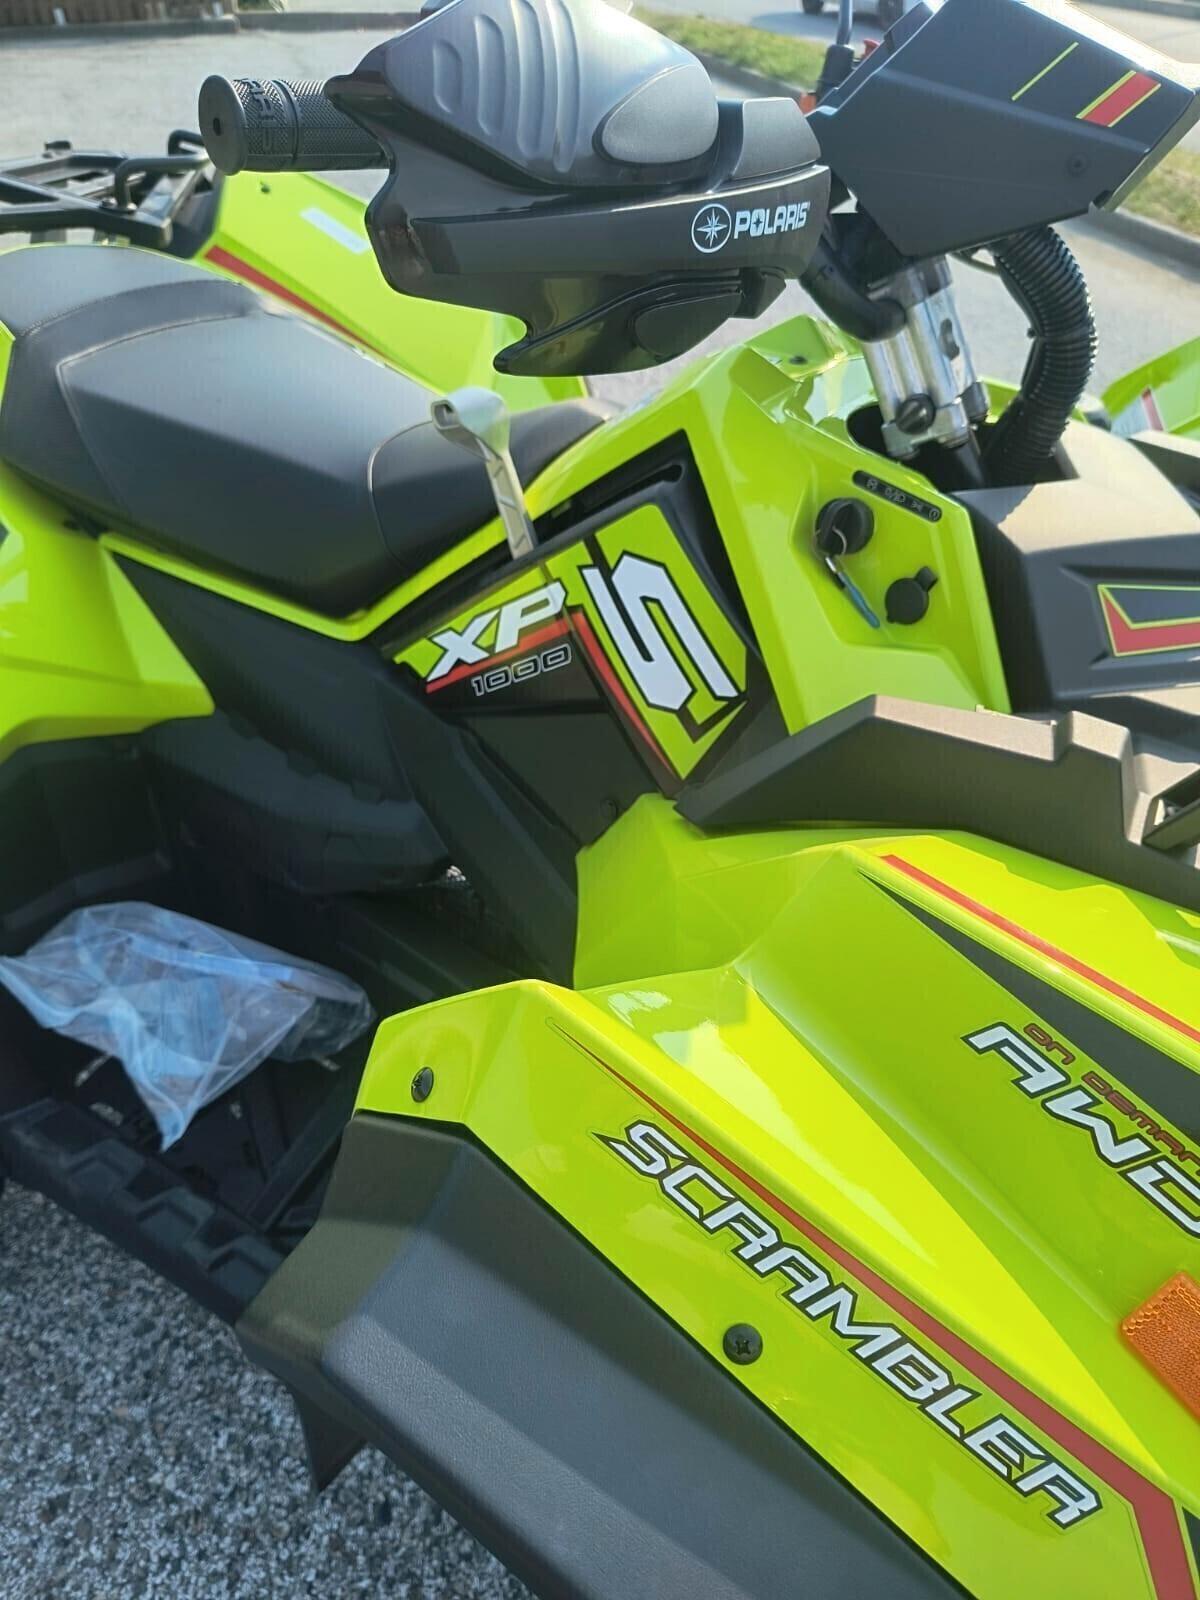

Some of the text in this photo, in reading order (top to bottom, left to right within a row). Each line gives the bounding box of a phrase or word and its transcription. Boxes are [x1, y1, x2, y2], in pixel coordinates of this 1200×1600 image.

[734, 201, 810, 239] POLARIS
[424, 579, 568, 683] XP
[471, 643, 573, 697] 1000
[595, 1120, 1102, 1528] SCRAMBLER
